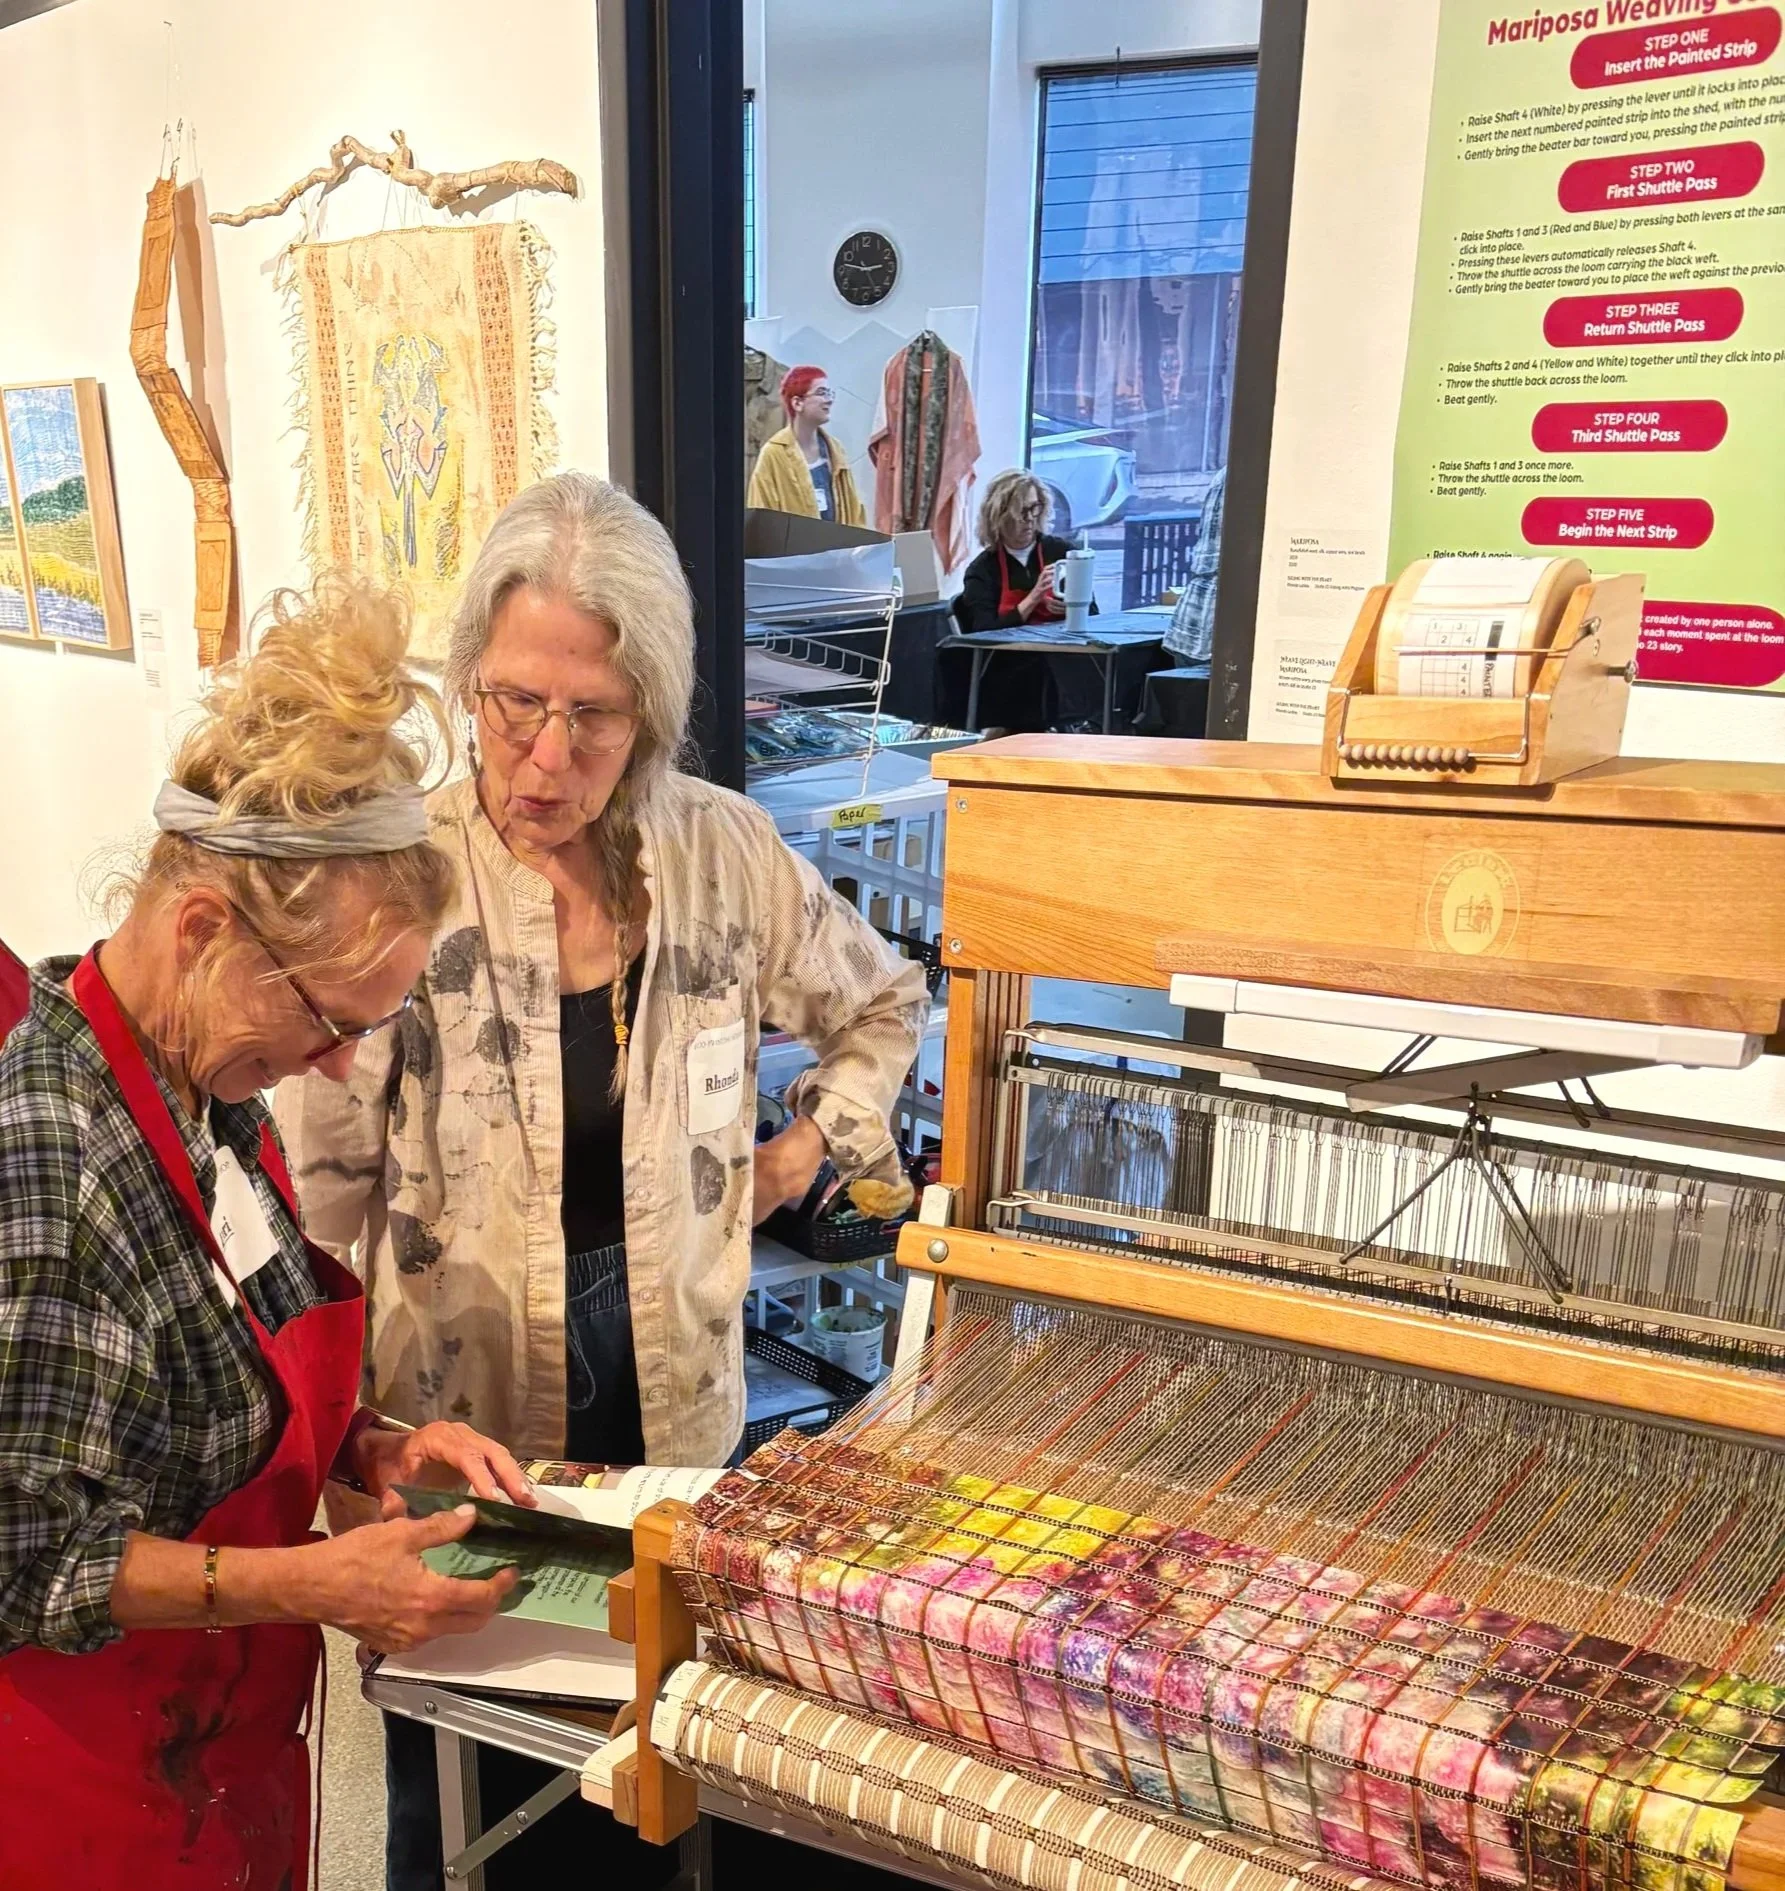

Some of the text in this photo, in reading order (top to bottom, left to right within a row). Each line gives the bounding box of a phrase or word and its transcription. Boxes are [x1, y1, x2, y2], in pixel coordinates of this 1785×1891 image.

[1487, 0, 1717, 46] Mariposa Weaving
[1644, 28, 1710, 51] STEP ONE
[1604, 38, 1758, 76] Insert the Painted Strip
[1468, 114, 1493, 127] Raise
[1494, 110, 1520, 123] Shaft
[1521, 109, 1528, 120] 4
[1530, 103, 1566, 120] (White)
[1567, 103, 1580, 115] by
[1581, 96, 1624, 114] pressing
[1626, 94, 1643, 106] the
[1644, 90, 1671, 103] lever
[1672, 85, 1696, 99] until
[1697, 84, 1706, 96] it
[1707, 81, 1736, 95] locks
[1737, 77, 1760, 91] into
[1464, 148, 1493, 161] Gently
[1494, 144, 1520, 158] bring
[1521, 142, 1537, 153] the
[1538, 138, 1572, 152] beater
[1572, 137, 1590, 149] bar
[1591, 131, 1628, 146] toward
[1630, 131, 1651, 142] you,
[1652, 123, 1698, 140] pressing
[1700, 121, 1717, 132] the
[1718, 114, 1761, 132] painted
[1629, 159, 1695, 179] STEP TWO
[1606, 176, 1718, 201] First Shuttle Pass
[1460, 230, 1485, 243] Raise
[1486, 227, 1514, 240] Shafts
[1522, 226, 1540, 237] and
[1541, 225, 1548, 236] 3
[1549, 223, 1572, 236] (Red
[1573, 221, 1591, 232] and
[1592, 219, 1618, 231] Blue)
[1619, 219, 1632, 230] by
[1633, 214, 1674, 229] pressing
[1676, 212, 1700, 224] both
[1701, 208, 1732, 221] levers
[1734, 208, 1746, 219] at
[1747, 206, 1765, 218] the
[1458, 241, 1697, 268] Pressing these levers automatically releases Shaft 4.
[1457, 252, 1720, 282] Throw the shuttle across the loom carrying the black weft.
[1455, 284, 1483, 295] Gently
[1484, 282, 1507, 294] bring
[1509, 280, 1525, 291] the
[1525, 277, 1555, 290] beater
[1557, 275, 1590, 288] toward
[1591, 277, 1609, 288] you
[1610, 274, 1621, 284] to
[1622, 271, 1649, 285] place
[1650, 269, 1667, 281] the
[1669, 268, 1690, 279] weft
[1692, 266, 1730, 280] against
[1732, 264, 1749, 276] the
[1605, 302, 1680, 319] STEP THREE
[1584, 318, 1706, 337] Return Shuttle Pass
[1447, 350, 1772, 373] Raise Shafts 2 and 4 (Yellow and White) together until they click into
[1594, 411, 1660, 426] STEP FOUR
[1571, 428, 1681, 443] Third Shuttle Pass
[1586, 508, 1645, 522] STEP FIVE
[1558, 523, 1678, 541] Begin the Next Strip
[1645, 614, 1775, 630] created by one person alone.
[1643, 628, 1785, 644] each moment spent at the loom
[1646, 640, 1658, 650] 23
[1659, 641, 1684, 654] story.
